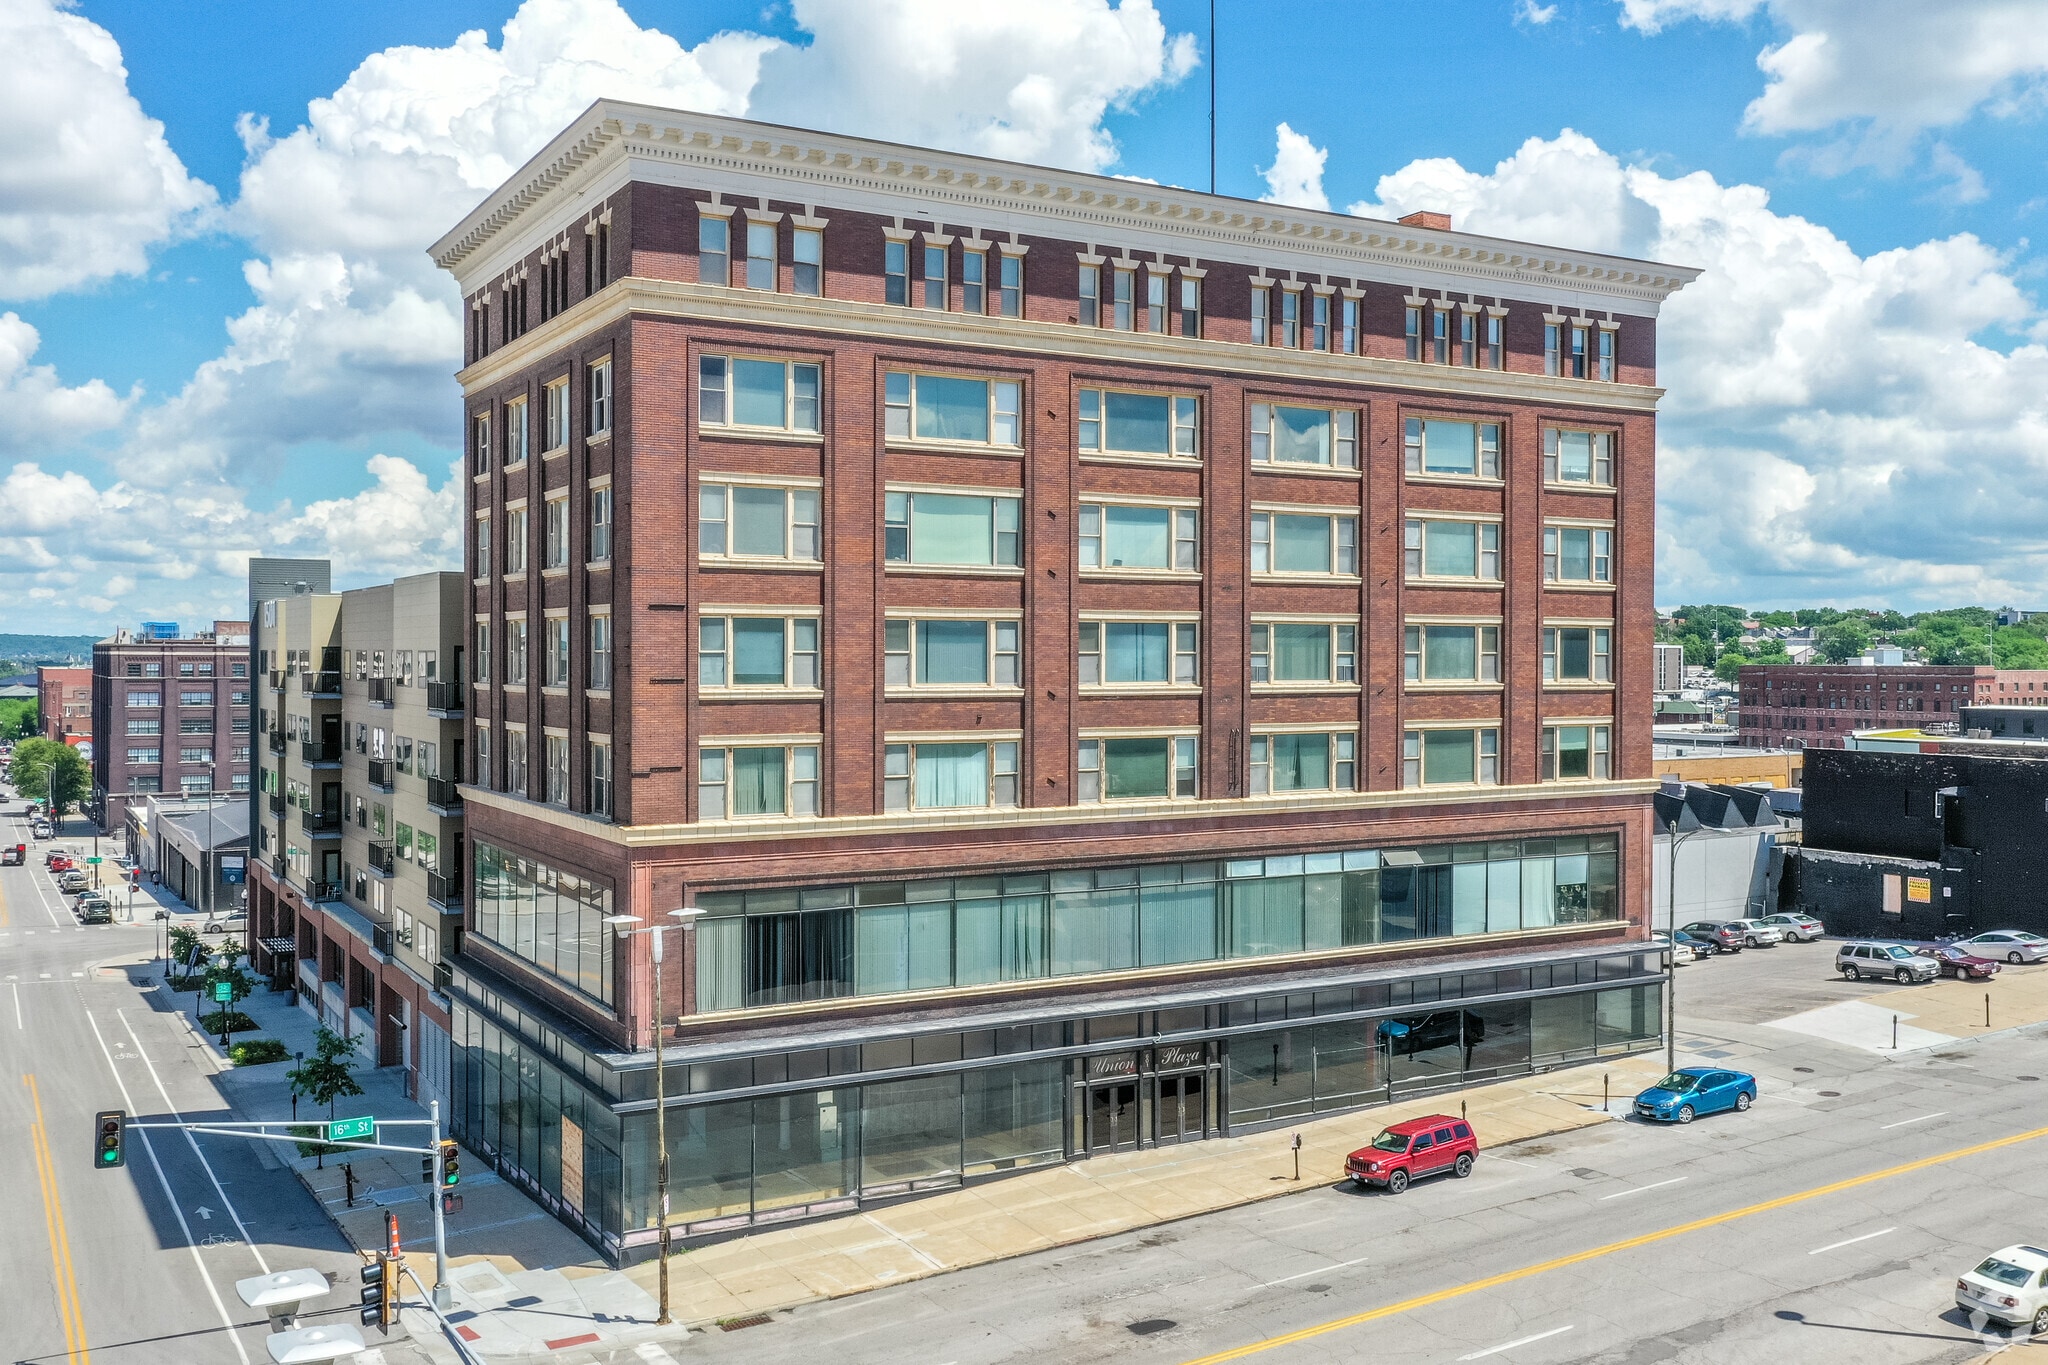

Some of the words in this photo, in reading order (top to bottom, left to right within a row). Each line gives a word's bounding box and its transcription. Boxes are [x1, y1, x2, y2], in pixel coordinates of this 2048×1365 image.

[1093, 1057, 1135, 1074] Union
[1161, 1047, 1200, 1067] Plaza
[333, 1123, 350, 1136] 16th
[358, 1121, 369, 1133] St
